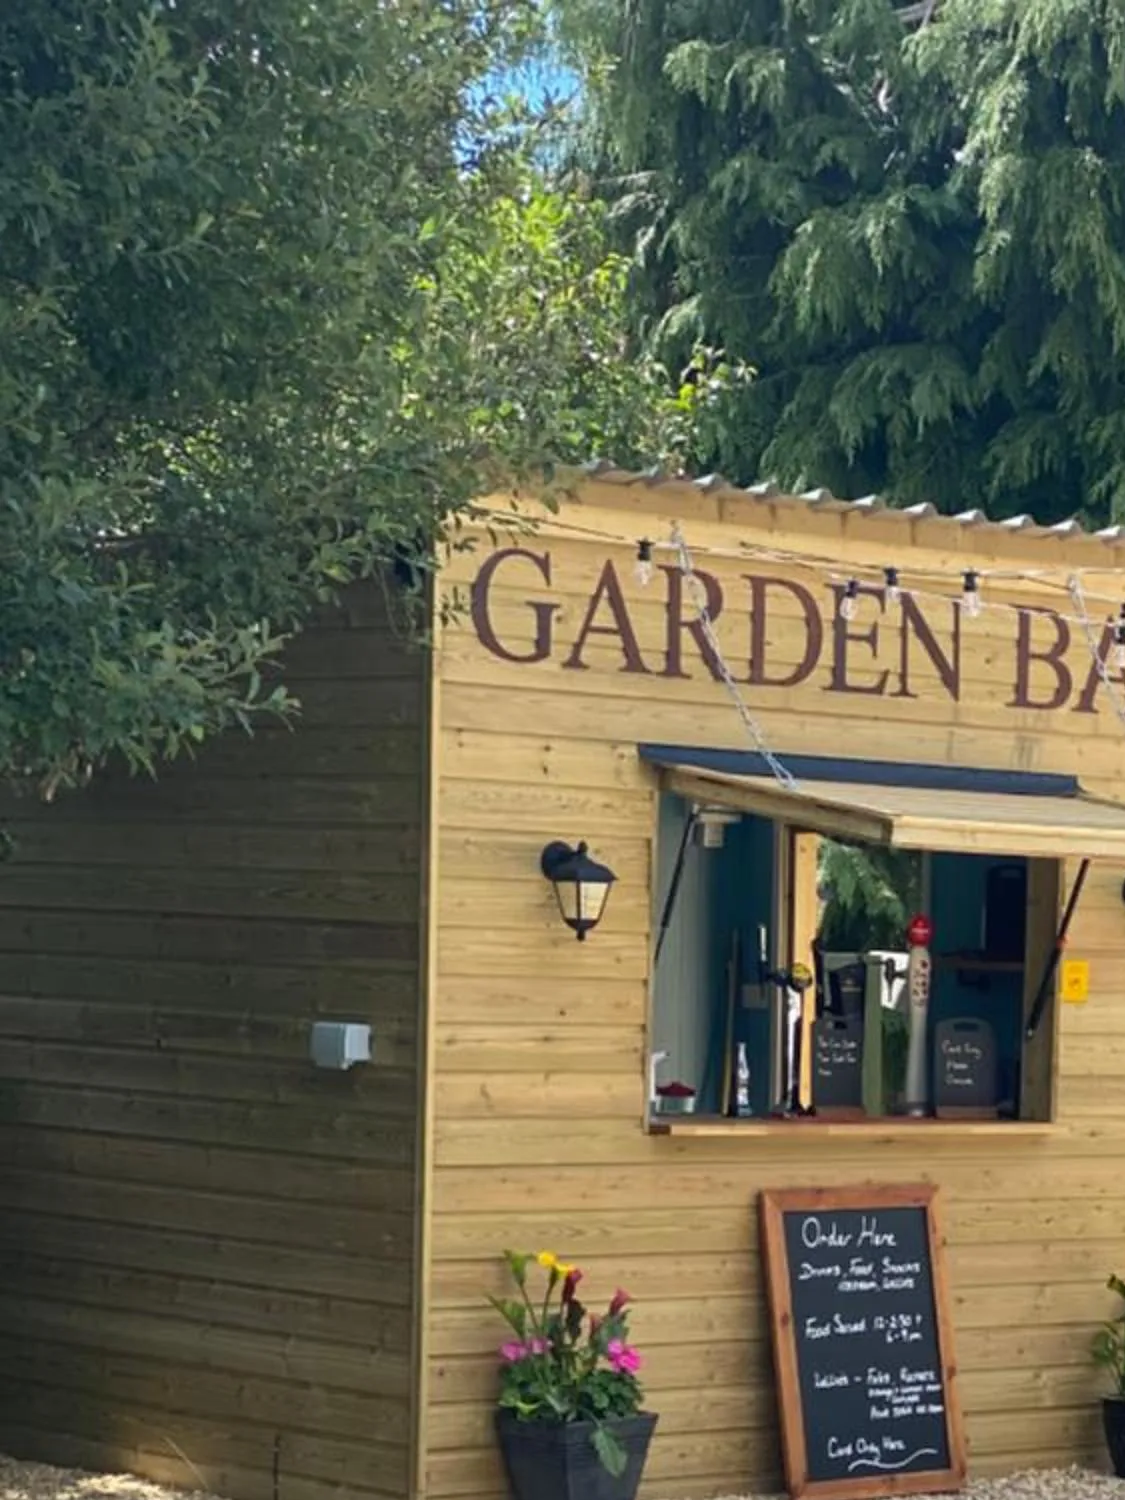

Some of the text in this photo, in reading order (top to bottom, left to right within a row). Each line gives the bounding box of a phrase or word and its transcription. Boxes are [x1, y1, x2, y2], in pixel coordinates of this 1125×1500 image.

[471, 548, 964, 701] GARDEN
[802, 1216, 896, 1248] Order Here
[805, 1317, 831, 1340] Food
